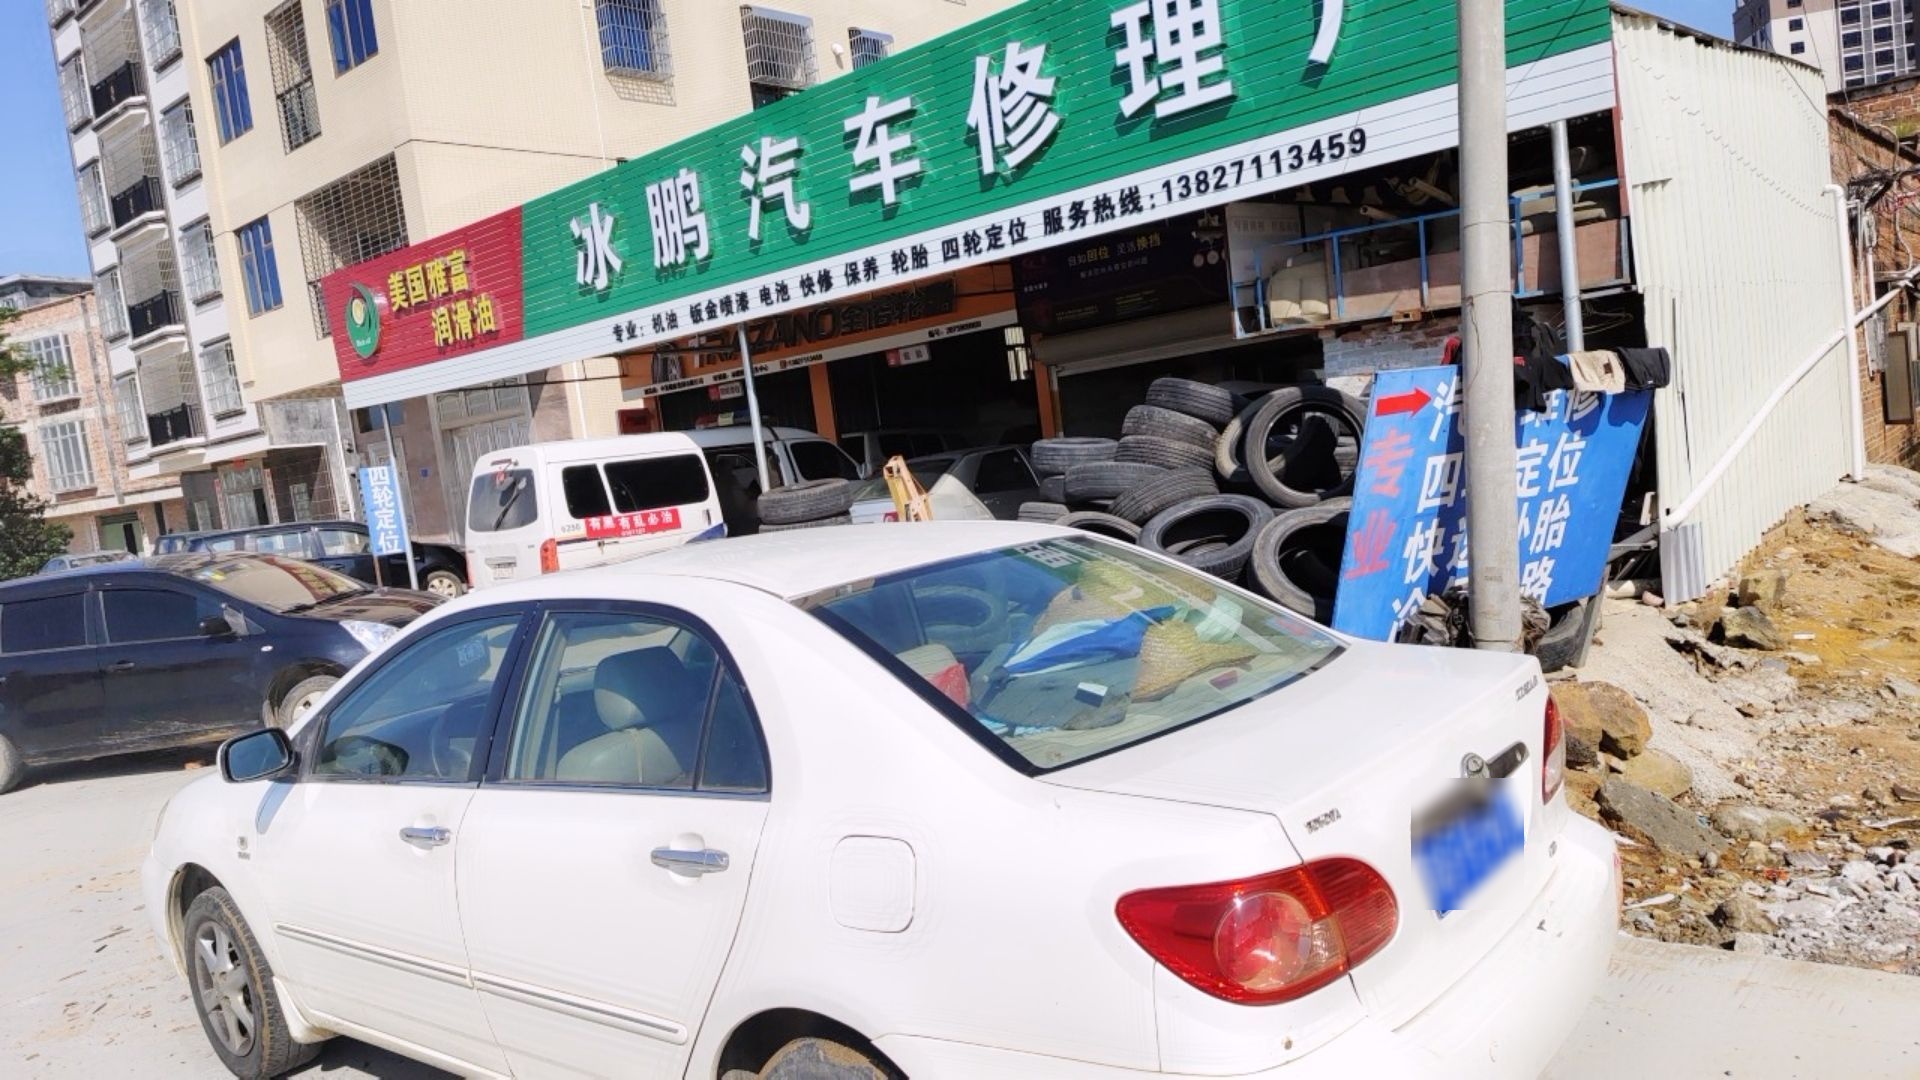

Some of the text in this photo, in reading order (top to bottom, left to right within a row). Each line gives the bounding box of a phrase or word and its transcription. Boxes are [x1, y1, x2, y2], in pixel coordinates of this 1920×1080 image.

[388, 249, 469, 312] 美国雅富
[651, 309, 679, 334] 机油
[690, 291, 749, 324] 钣金喷漆
[759, 280, 790, 306] 电池
[799, 268, 833, 297] 快修
[844, 257, 879, 286] 保养
[891, 244, 928, 275] 轮胎
[942, 217, 1028, 261] 四轮定位
[432, 292, 496, 346] 润滑油
[368, 466, 403, 554] 四轮定位
[1345, 427, 1416, 580] 专业
[1417, 430, 1586, 513] 四定位
